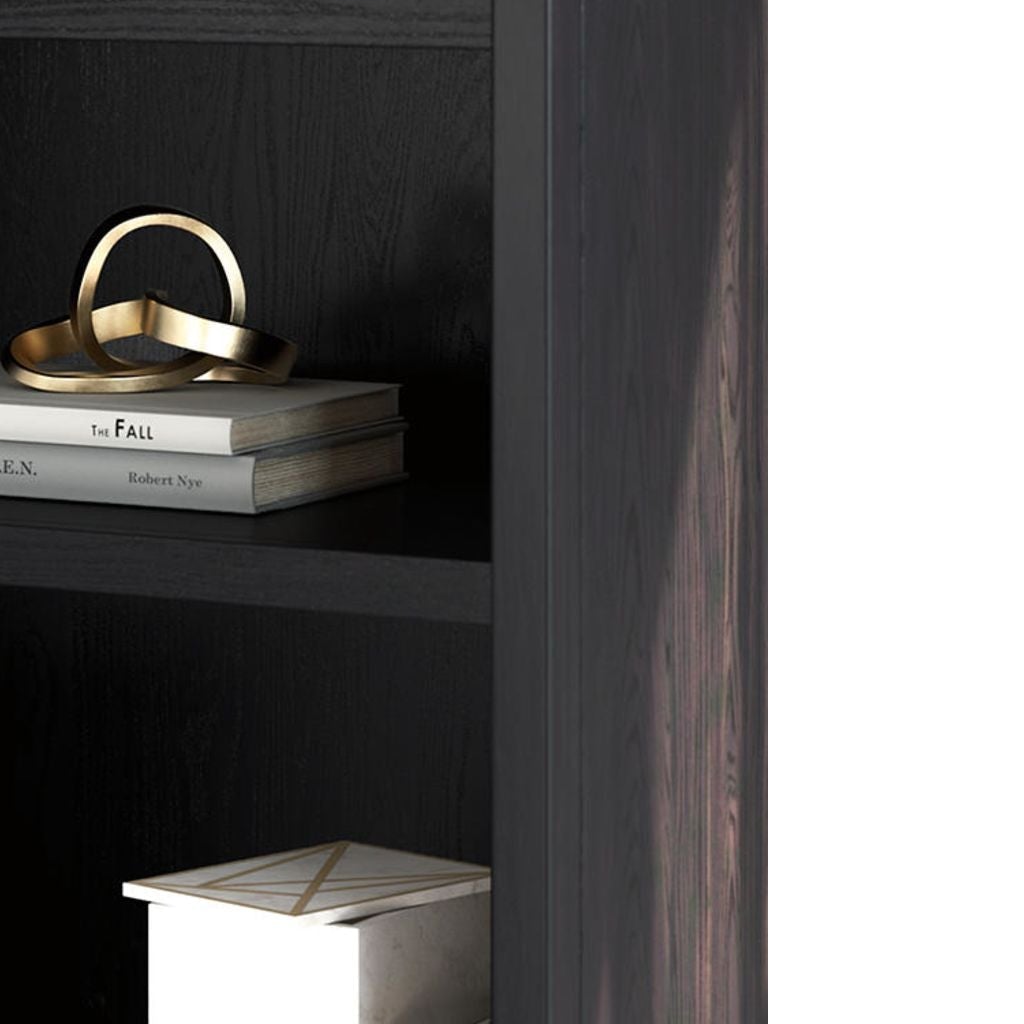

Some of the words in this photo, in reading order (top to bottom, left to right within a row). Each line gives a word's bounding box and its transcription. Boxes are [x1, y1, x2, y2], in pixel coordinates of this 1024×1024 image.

[92, 425, 108, 437] THE
[115, 419, 153, 440] FALL
[129, 472, 173, 485] Robert
[178, 475, 202, 490] Nye
